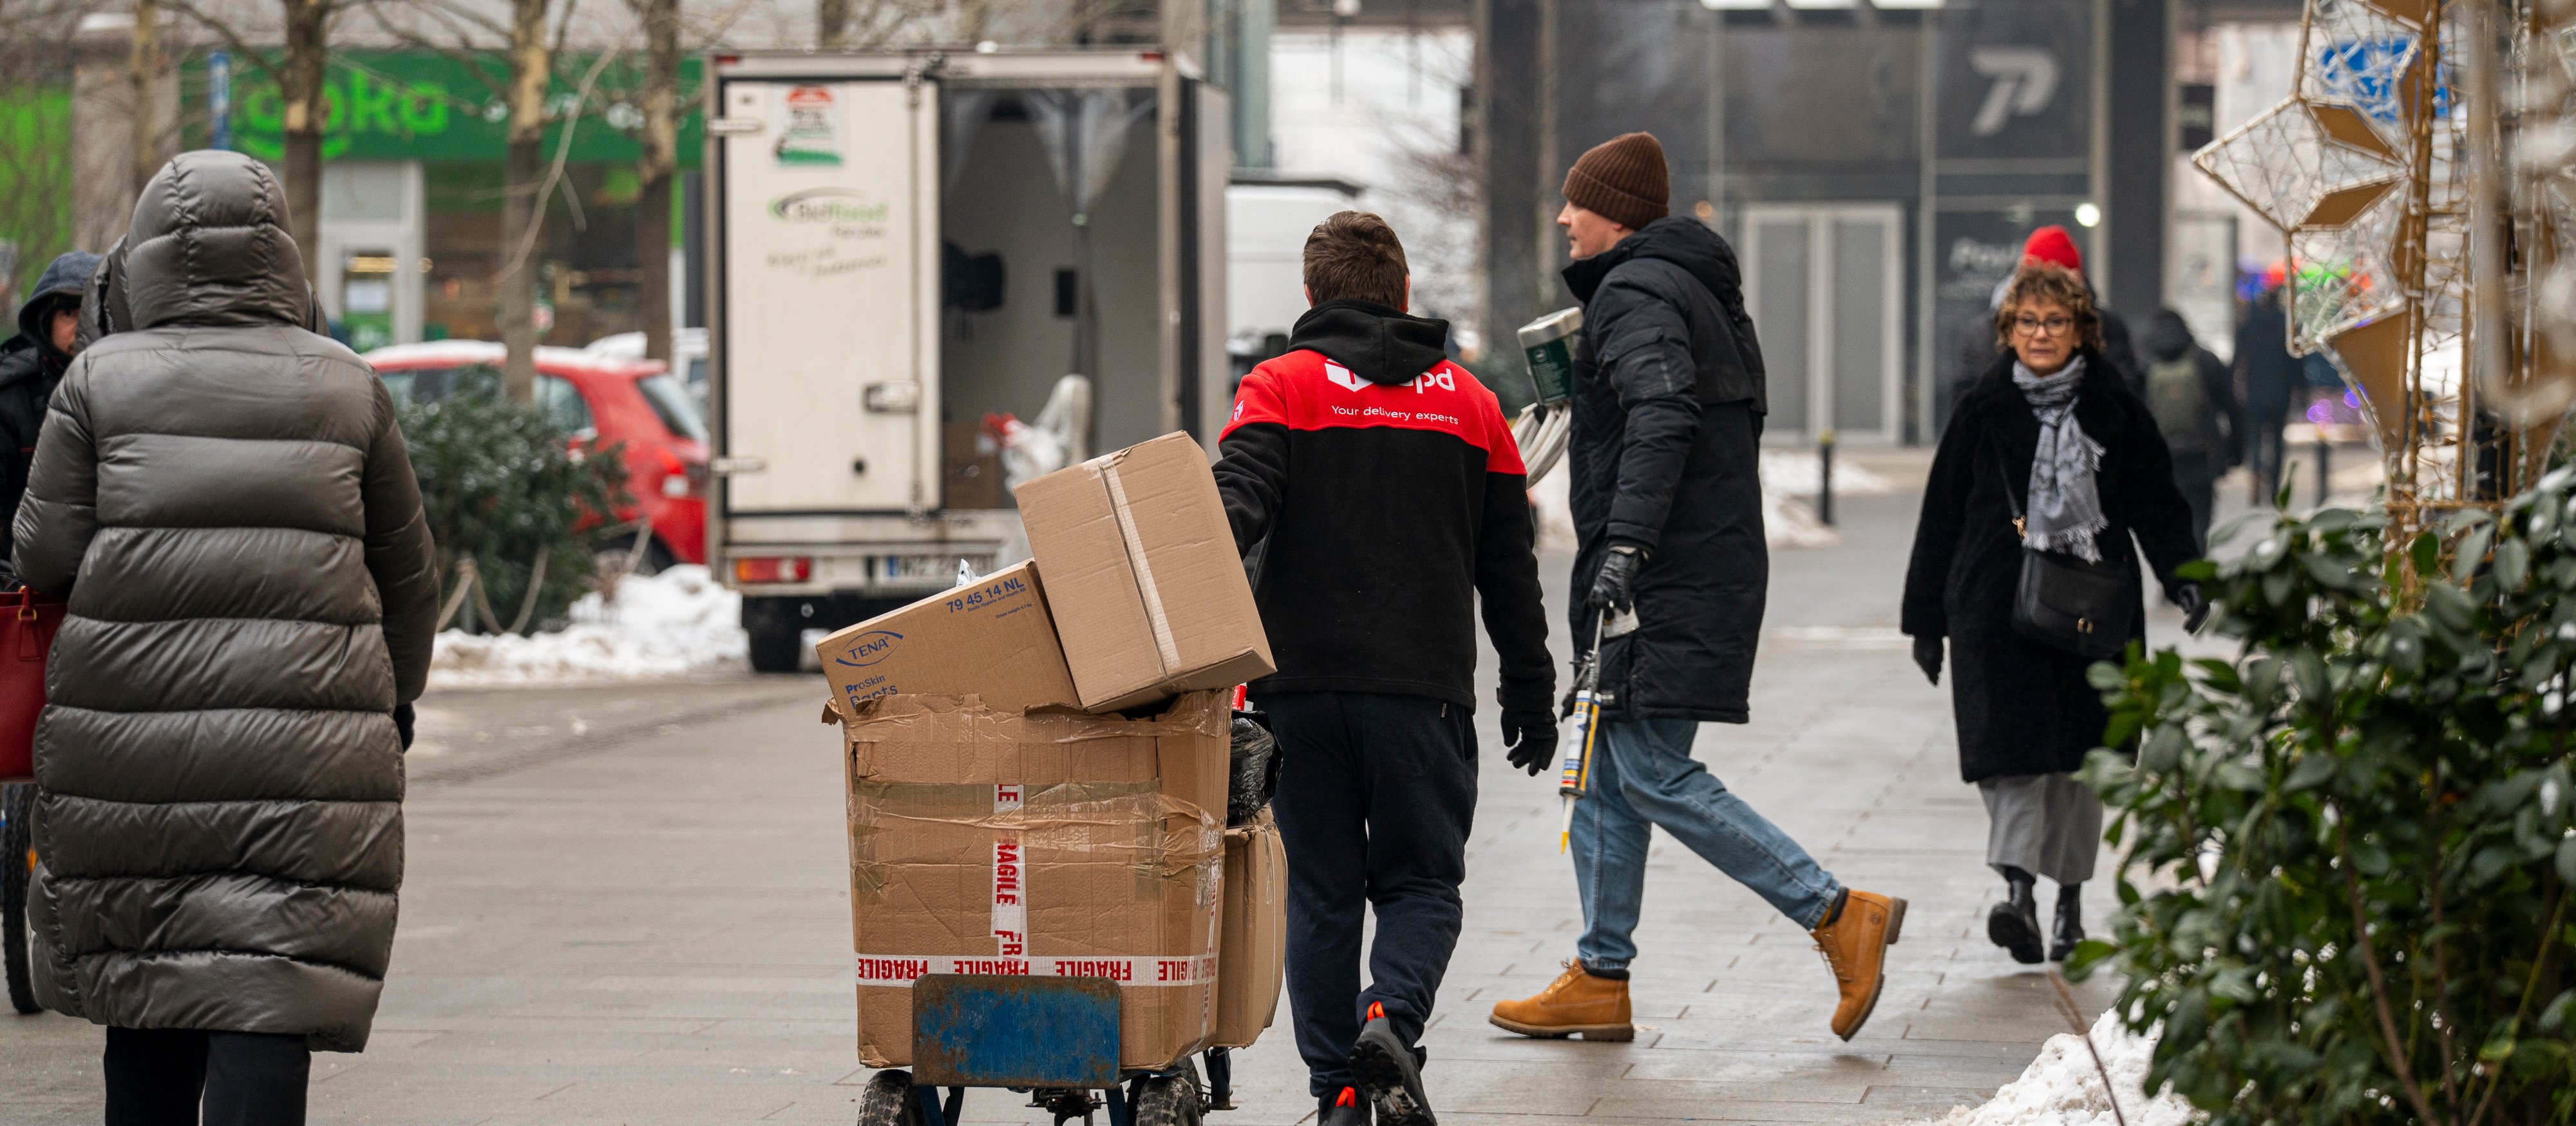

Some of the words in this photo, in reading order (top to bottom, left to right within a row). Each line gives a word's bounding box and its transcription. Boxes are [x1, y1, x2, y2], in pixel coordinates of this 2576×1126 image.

[1398, 368, 1456, 394] pd
[1331, 405, 1359, 416] Your
[1363, 406, 1411, 421] delivery
[1416, 412, 1459, 425] experts
[946, 599, 963, 613] 79
[967, 591, 983, 605] 45
[985, 584, 1001, 598] 14
[1003, 577, 1025, 592] NL
[981, 599, 997, 608] Hygiene
[1006, 589, 1019, 598] Health
[846, 675, 886, 694] ProSkin
[996, 837, 1020, 906] RAGILE
[858, 958, 928, 981] FRAGILE
[953, 960, 1029, 975] FRAGILE
[1055, 960, 1132, 981] FRAGILE
